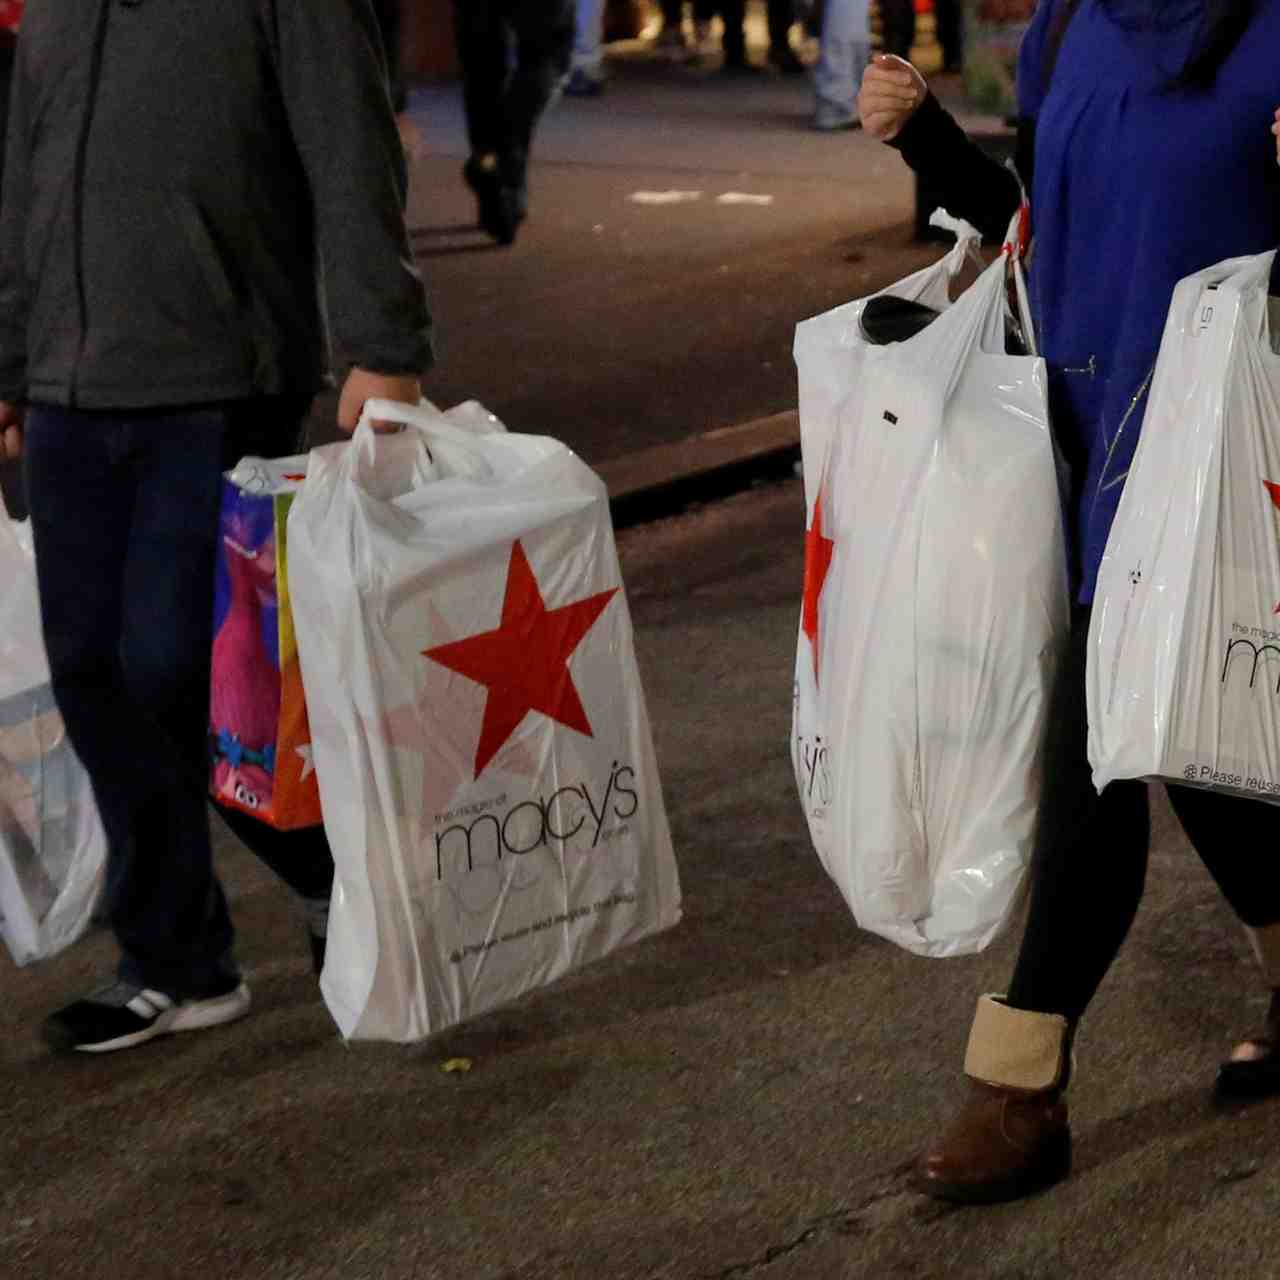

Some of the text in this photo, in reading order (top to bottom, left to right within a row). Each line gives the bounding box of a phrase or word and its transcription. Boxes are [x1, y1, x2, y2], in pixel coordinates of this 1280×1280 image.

[1200, 766, 1242, 786] Please
[1246, 776, 1280, 793] reuse
[435, 760, 638, 880] macy's
